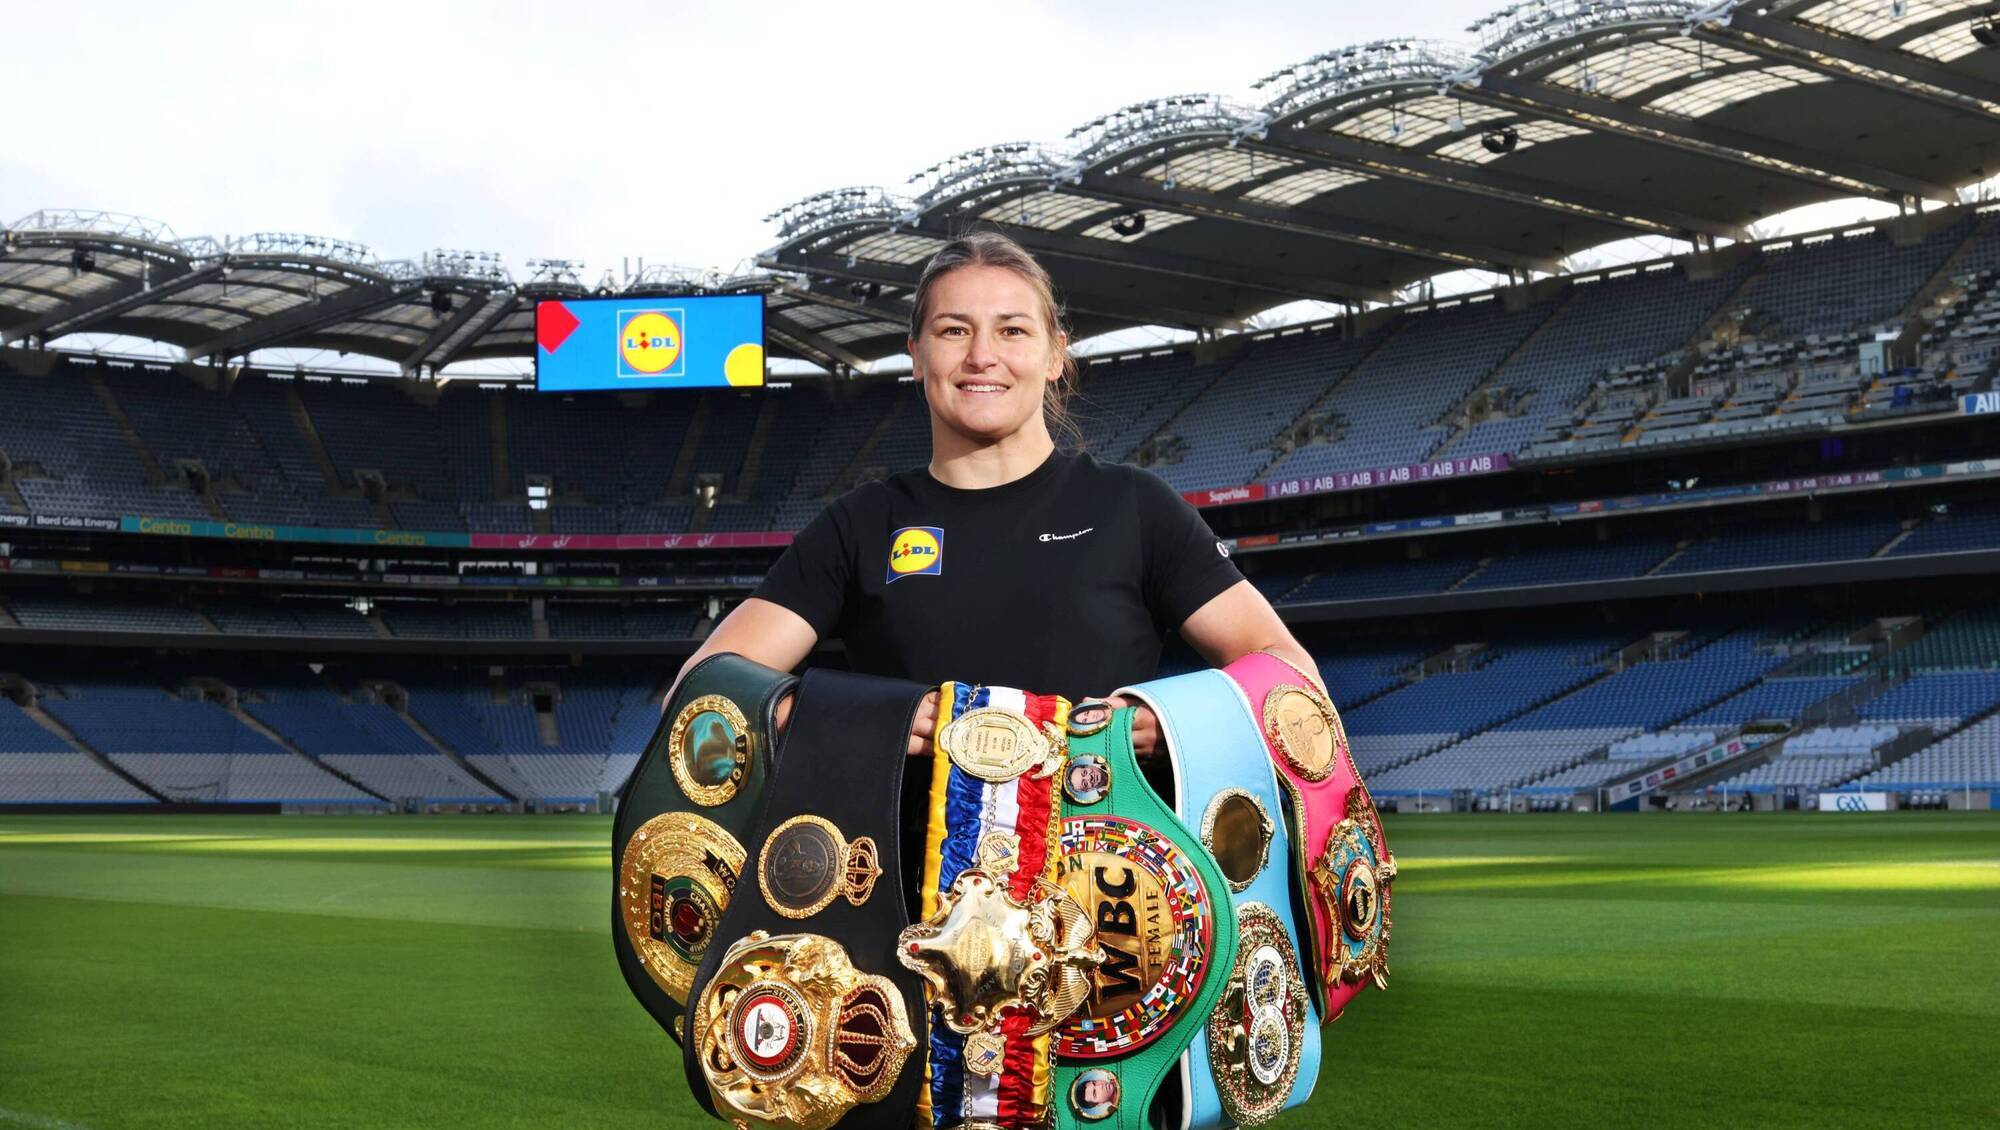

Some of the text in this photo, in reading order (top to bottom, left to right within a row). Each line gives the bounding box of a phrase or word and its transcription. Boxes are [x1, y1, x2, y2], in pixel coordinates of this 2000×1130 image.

[1280, 457, 1491, 496] AIB AIB AIB AIB AIB AIB
[1208, 487, 1250, 505] SuperValu
[0, 514, 29, 526] nergy
[36, 515, 60, 526] Bord
[84, 517, 119, 530] Energy
[139, 518, 192, 535] Centra
[224, 522, 274, 539] Centra
[375, 530, 426, 545] Centra
[1038, 526, 1094, 543] Champion
[651, 882, 663, 934] IBO
[664, 893, 675, 934] BOXING
[689, 892, 714, 954] CHAMPIONSHIP
[1094, 866, 1139, 999] WBC
[1145, 890, 1161, 968] FEMALE
[772, 989, 802, 1017] SUPER
